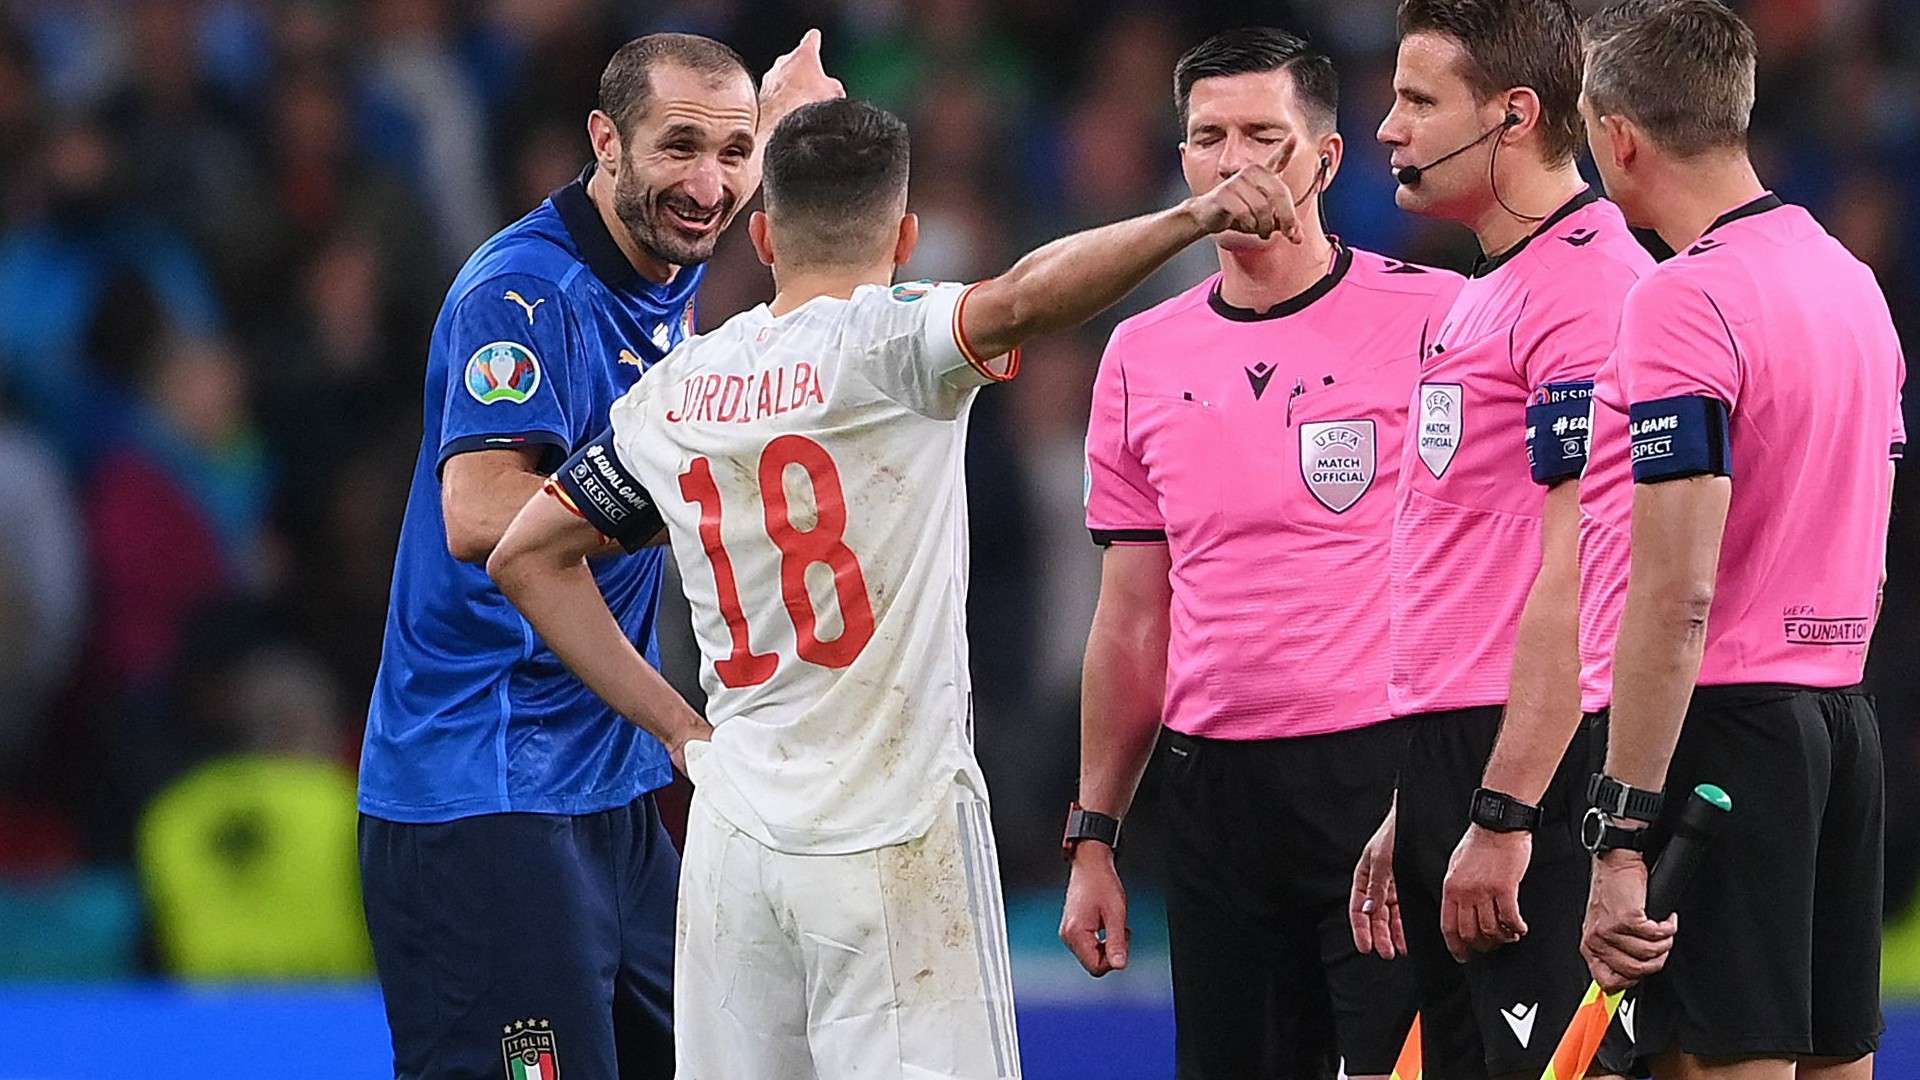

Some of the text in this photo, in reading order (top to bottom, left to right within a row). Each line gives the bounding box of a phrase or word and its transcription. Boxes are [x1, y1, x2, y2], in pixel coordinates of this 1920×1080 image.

[666, 361, 825, 423] JORDI ALBA
[1314, 431, 1358, 447] UEFA
[1632, 439, 1672, 459] SPECT
[1317, 458, 1361, 468] MATCH
[586, 445, 648, 510] #EQUAL GAME
[1312, 472, 1365, 483] OFFICIAL
[583, 477, 628, 521] RESPECT
[678, 433, 876, 690] 18
[1783, 605, 1815, 616] UEFA
[508, 1035, 550, 1052] ITALIA
